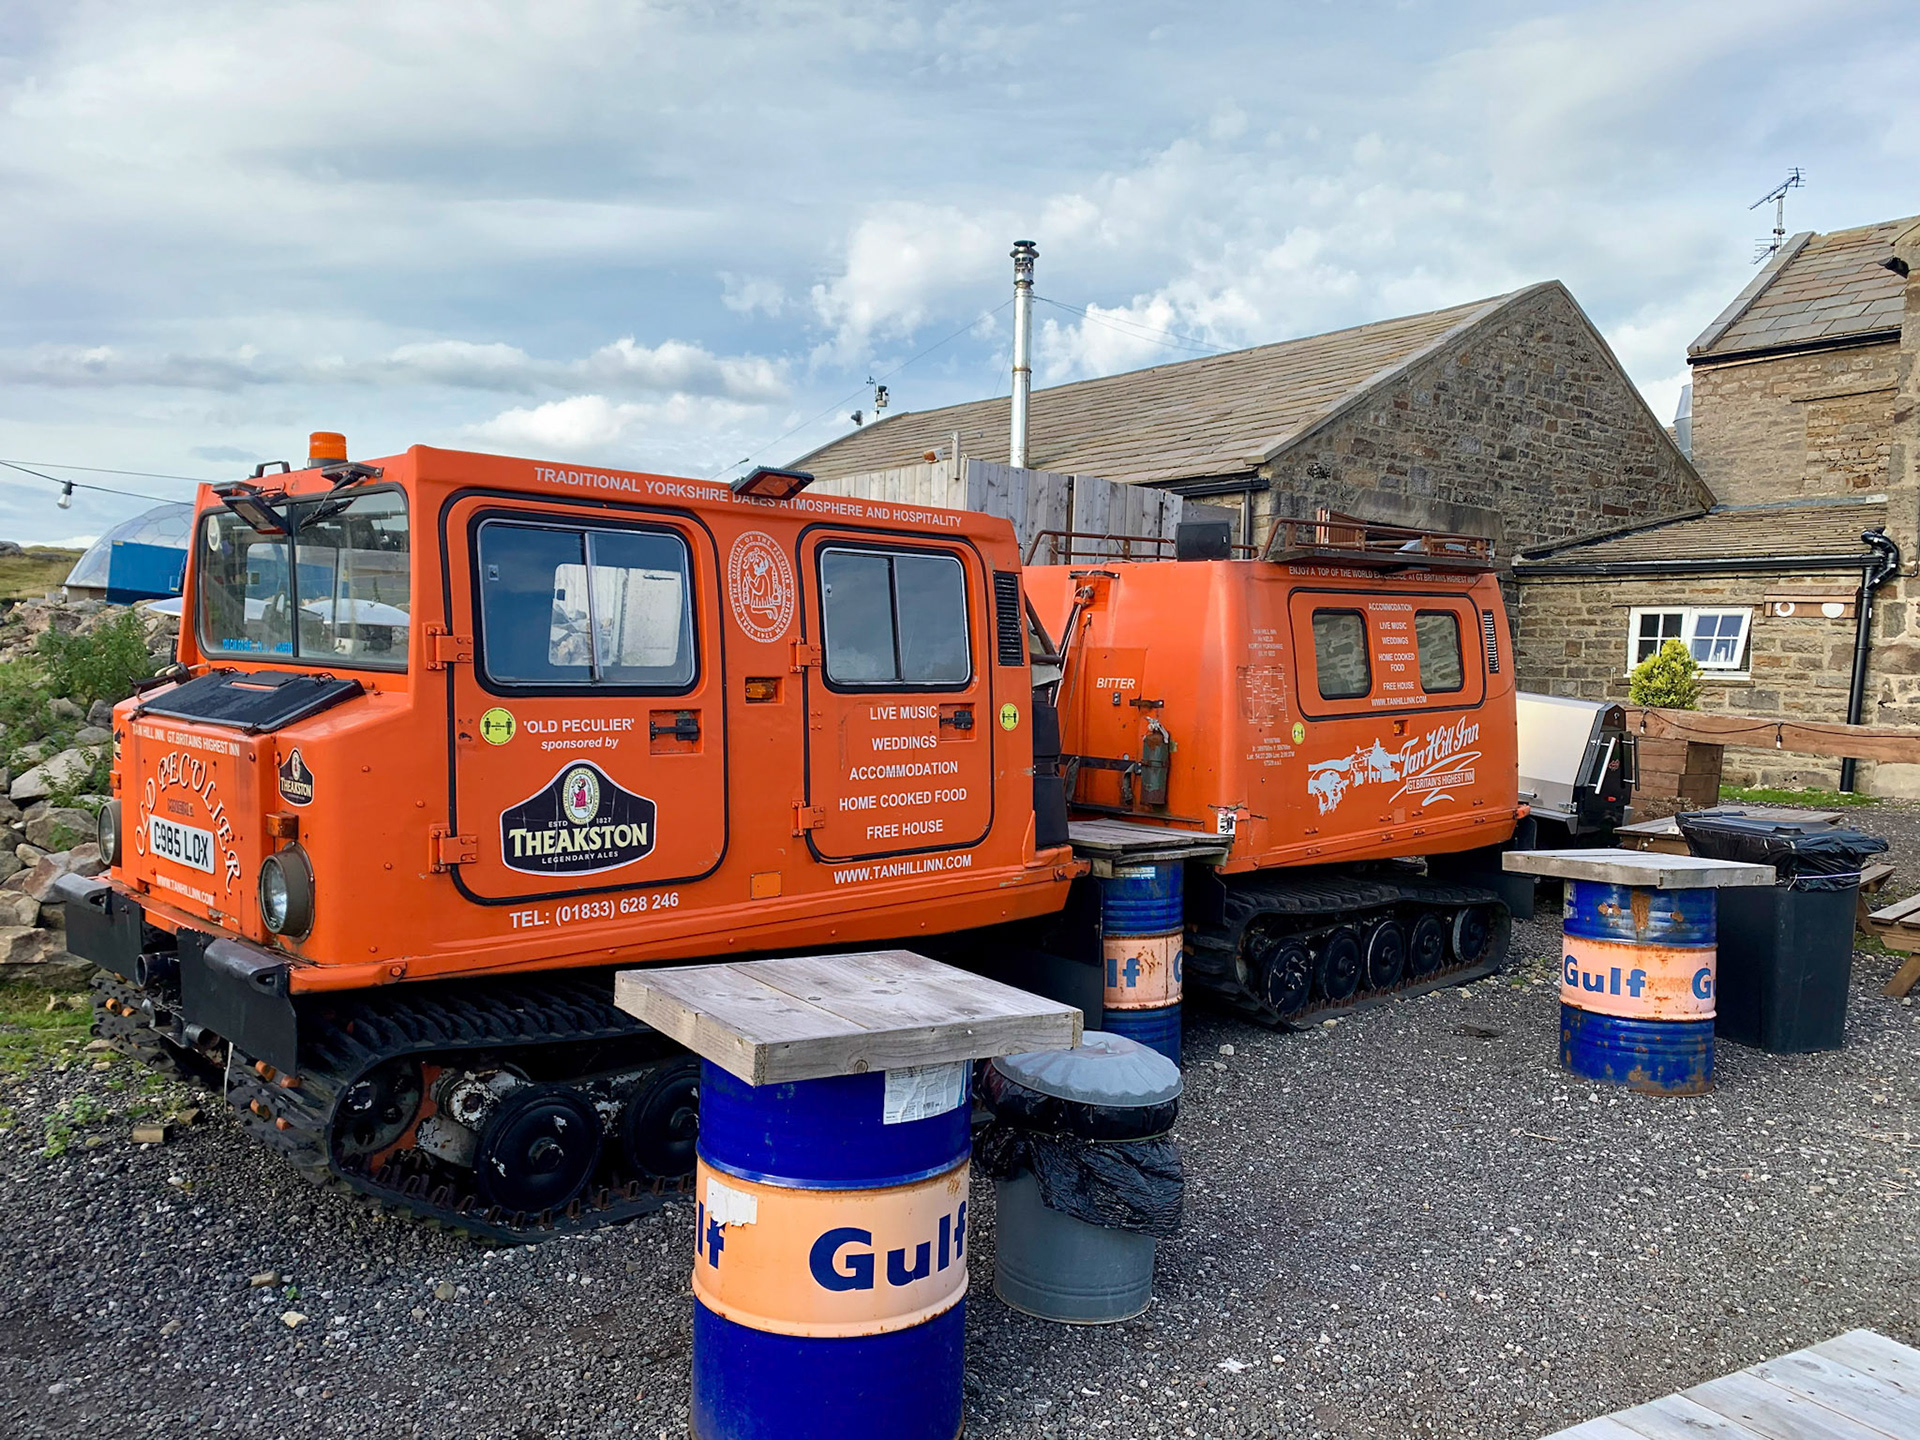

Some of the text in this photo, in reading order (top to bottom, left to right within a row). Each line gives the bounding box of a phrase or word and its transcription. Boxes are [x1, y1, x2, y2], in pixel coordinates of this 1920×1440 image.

[534, 467, 640, 492] TRADITIONAL
[645, 481, 728, 502] YORKSHIRE
[779, 498, 863, 517] ATMOSPHERE
[866, 507, 889, 520] AND
[892, 509, 961, 527] HOSPITALITY
[1289, 566, 1309, 575] ENJOY
[1311, 567, 1316, 575] A
[1317, 568, 1329, 577] TOP
[1331, 568, 1339, 577] OF
[1340, 569, 1351, 578] THE
[1352, 569, 1373, 578] WORLD
[1368, 603, 1412, 611] ACCOMMODATION
[1379, 622, 1407, 630] LIVE MUSIC
[1382, 637, 1409, 645] WEDDINGS
[1378, 652, 1415, 661] HOME COOKED
[1390, 664, 1405, 672] FOOD
[1096, 677, 1136, 689] BITTER
[1383, 681, 1414, 690] FREE HOUSE
[1371, 696, 1427, 706] WWW.TANHILLINN.COM
[870, 706, 937, 720] LIVE MUSIC
[523, 719, 557, 734] 'OLD
[562, 718, 635, 733] PECULIER'
[132, 723, 143, 736] TAN
[143, 725, 154, 739] HILL
[167, 730, 202, 749] GT.BRITAINS
[202, 737, 228, 755] HIGHEST
[228, 743, 240, 756] INN
[541, 737, 619, 752] sponsored by
[872, 735, 937, 750] WEDDINGS
[1400, 715, 1479, 778] Tan Hill Inn
[849, 761, 958, 780] ACCOMMODATION
[280, 777, 312, 797] THEAKSTON
[1408, 771, 1474, 790] GT.BRITAIN'S HIGHEST INN
[839, 788, 967, 811] HOME COOKED FOOD
[134, 751, 241, 895] OLD PECULIER
[548, 820, 568, 828] ESTD
[596, 817, 612, 825] 1827
[866, 820, 943, 840] FREE HOUSE
[154, 821, 209, 867] C985 LOX
[508, 823, 648, 858] THEAKSTON
[541, 851, 619, 865] LEGENDARY ALES
[833, 854, 972, 884] WWW.TANHILLINN.COM
[156, 874, 214, 906] WWW.TANHILLINN.COM
[509, 892, 679, 929] TEL: (01833) 628 246
[1564, 954, 1647, 998] Gulf
[808, 1200, 967, 1292] Gulf
